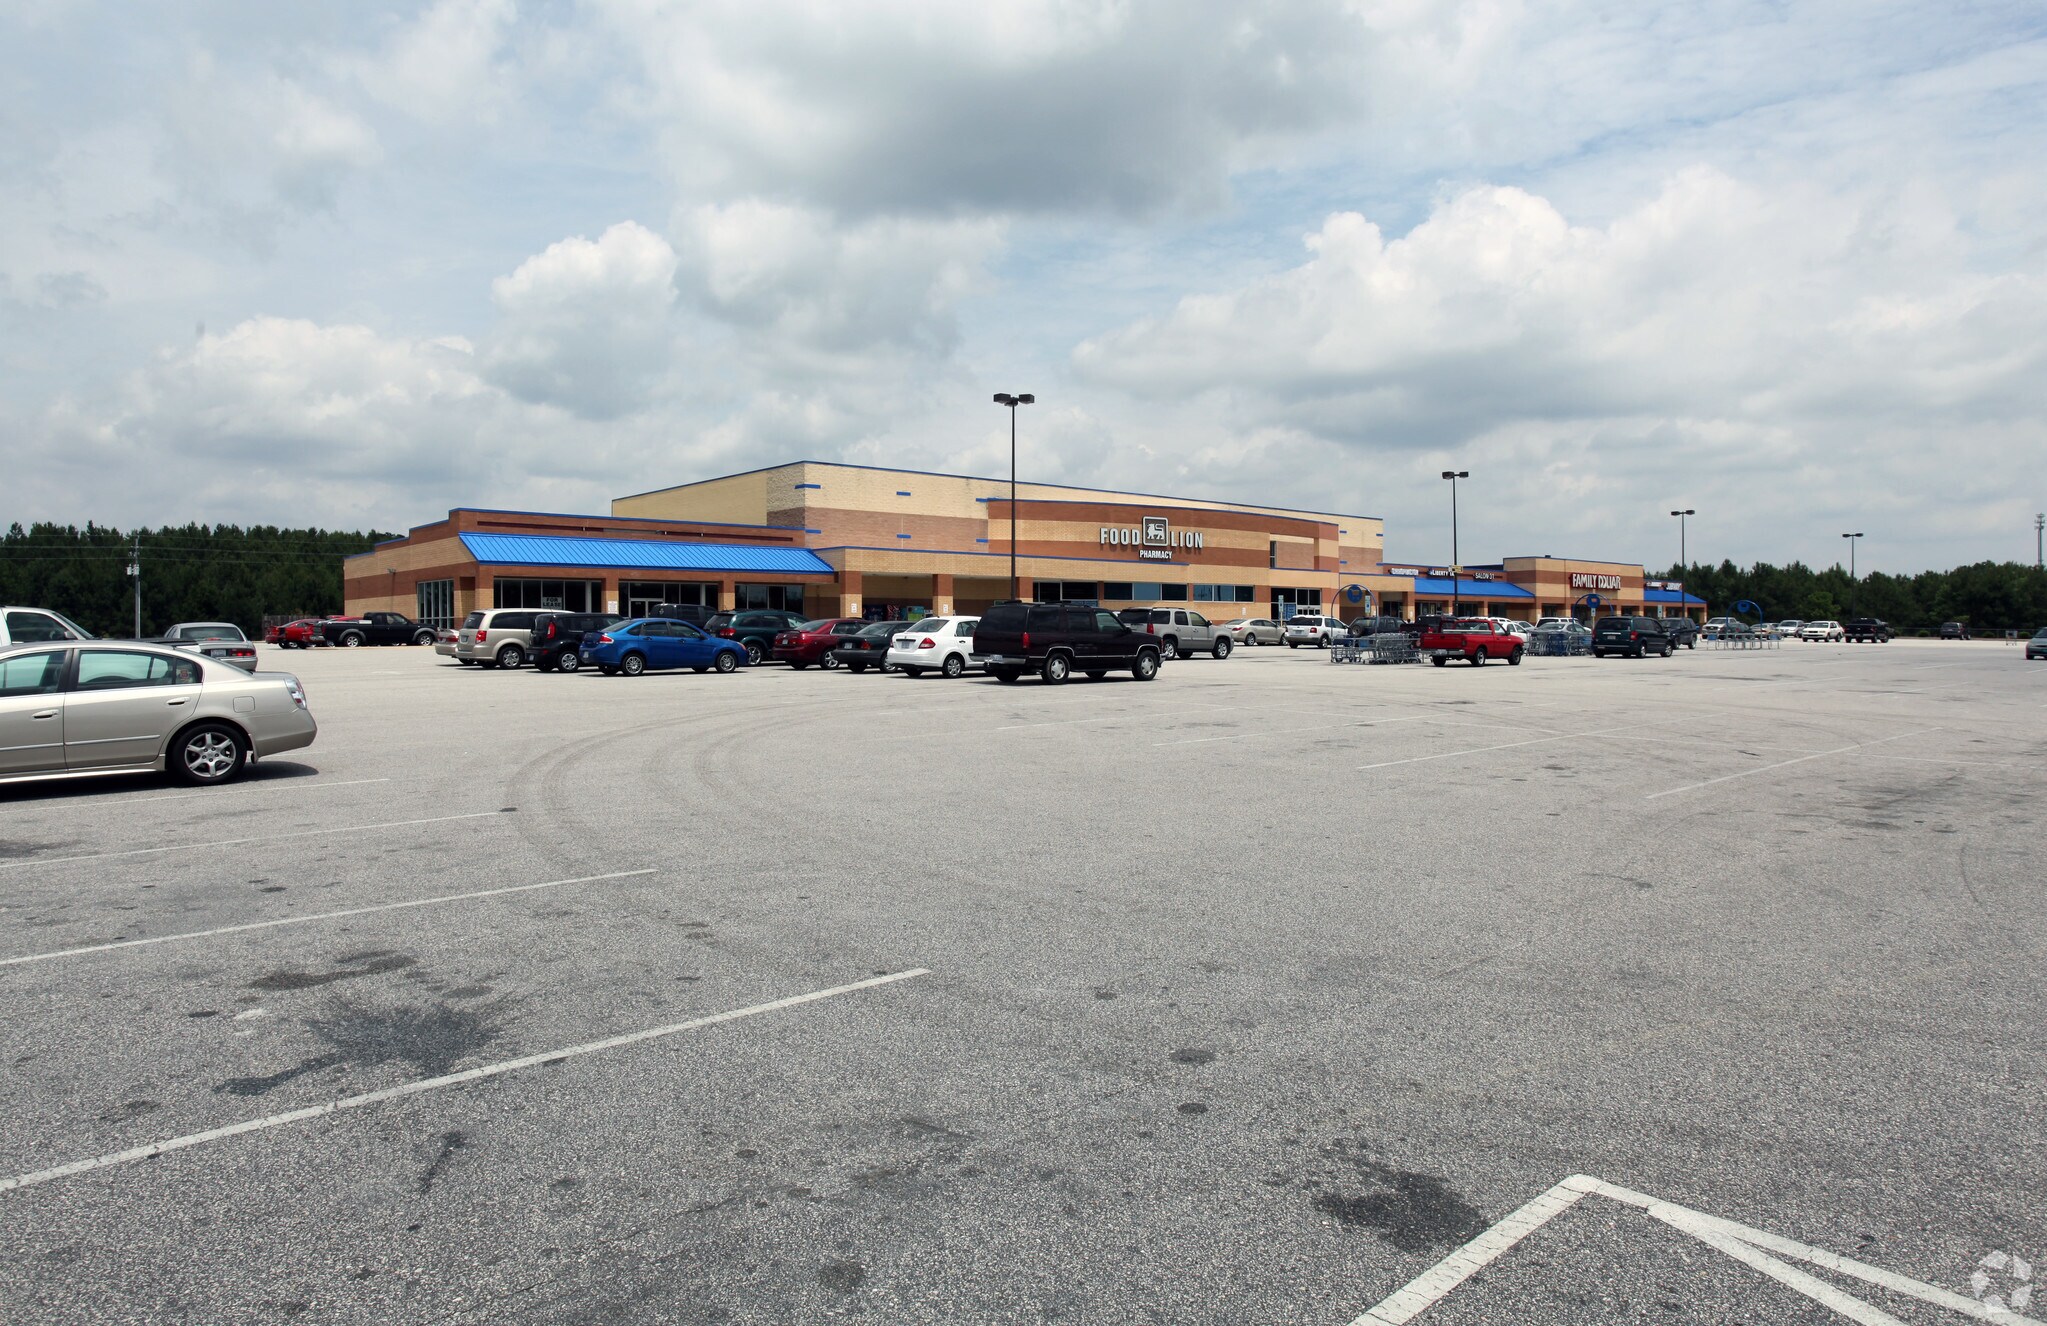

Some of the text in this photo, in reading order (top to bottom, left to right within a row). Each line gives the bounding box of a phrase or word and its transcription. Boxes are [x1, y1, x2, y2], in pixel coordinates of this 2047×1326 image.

[1100, 528, 1203, 548] FOOD LION
[1139, 549, 1173, 559] PHARMACY
[1572, 573, 1621, 590] FAMILY DOLLAR
